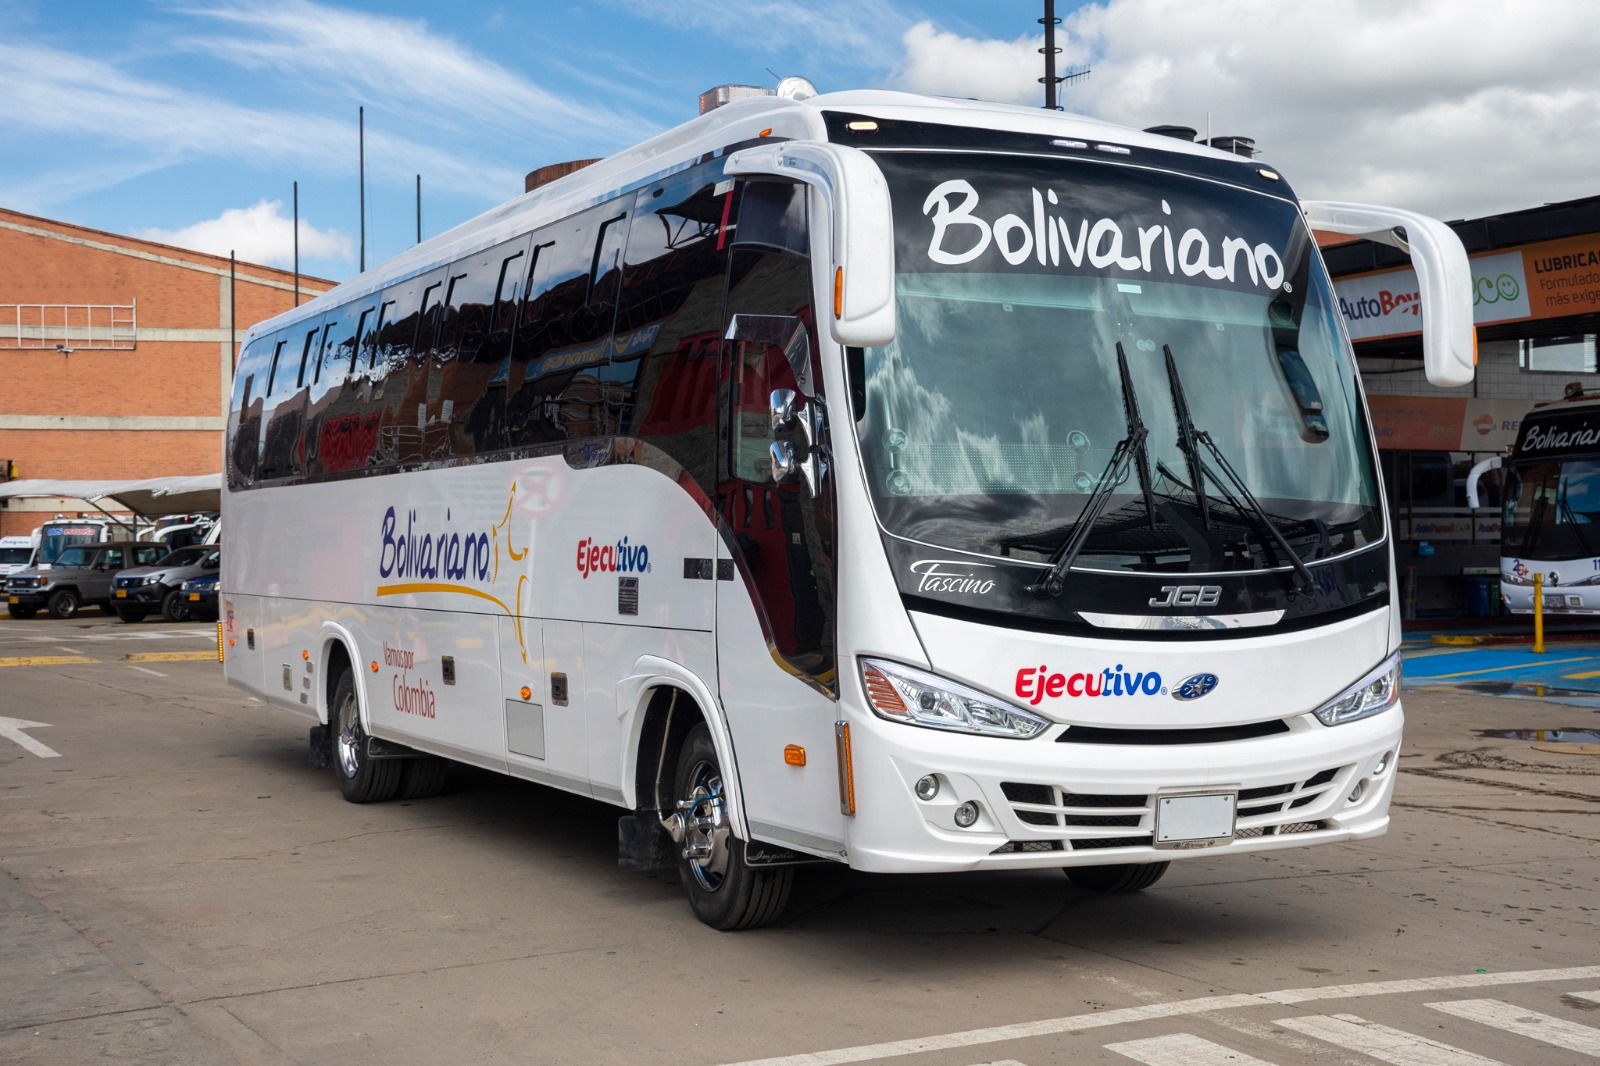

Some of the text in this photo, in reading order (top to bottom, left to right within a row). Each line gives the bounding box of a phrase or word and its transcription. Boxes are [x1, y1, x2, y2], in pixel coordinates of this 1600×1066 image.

[1534, 250, 1600, 274] LUBRICA
[1546, 291, 1570, 306] más
[1502, 420, 1522, 431] RE
[379, 506, 490, 582] Bolivariano
[577, 536, 648, 579] Ejecutivo
[910, 559, 996, 595] Fascino
[1148, 585, 1222, 608] JGB
[383, 640, 415, 674] Vamos por
[393, 674, 435, 719] Colombia
[1015, 663, 1162, 706] Ejecutivo
